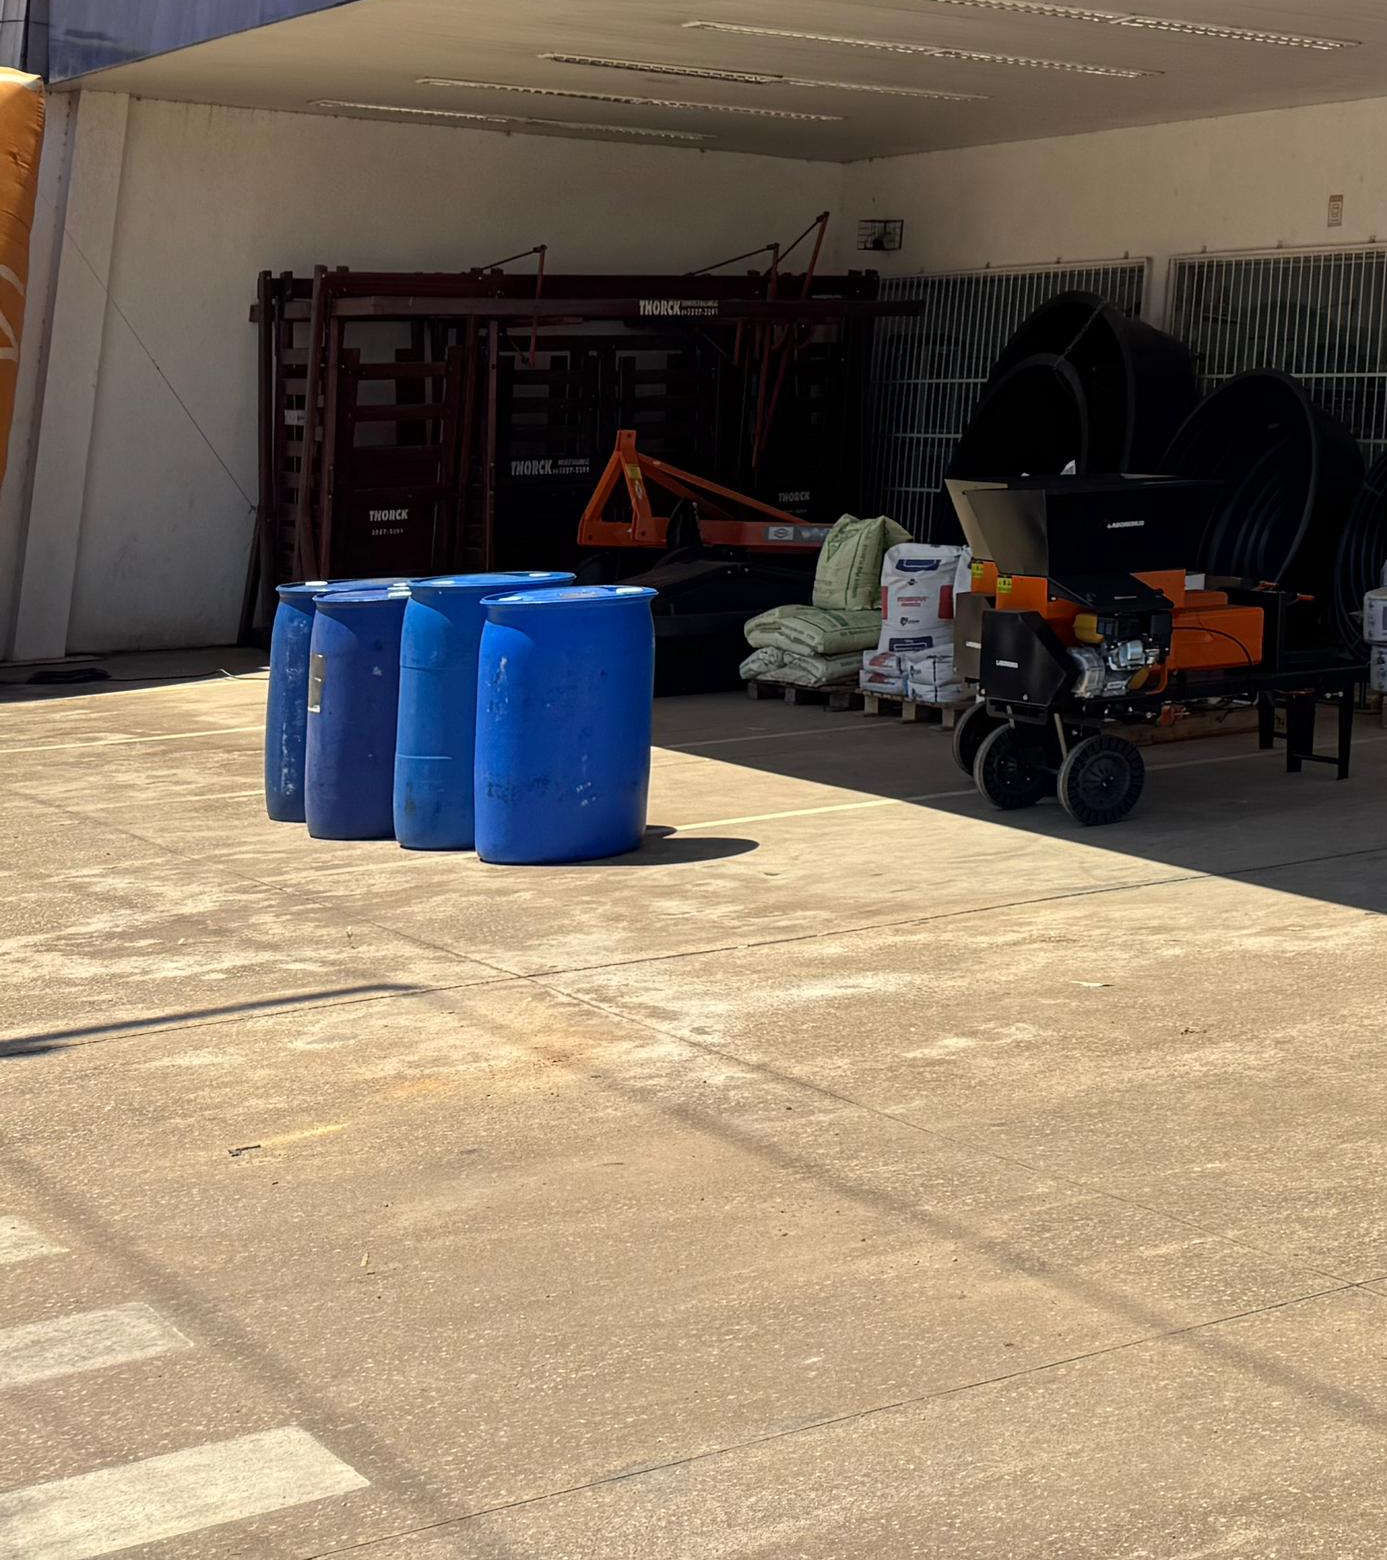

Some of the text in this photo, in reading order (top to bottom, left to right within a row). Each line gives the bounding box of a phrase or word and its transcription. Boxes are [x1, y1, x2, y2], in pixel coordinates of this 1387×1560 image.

[639, 299, 681, 316] THORCK
[511, 459, 553, 476] THORCK
[369, 509, 409, 522] THORCK
